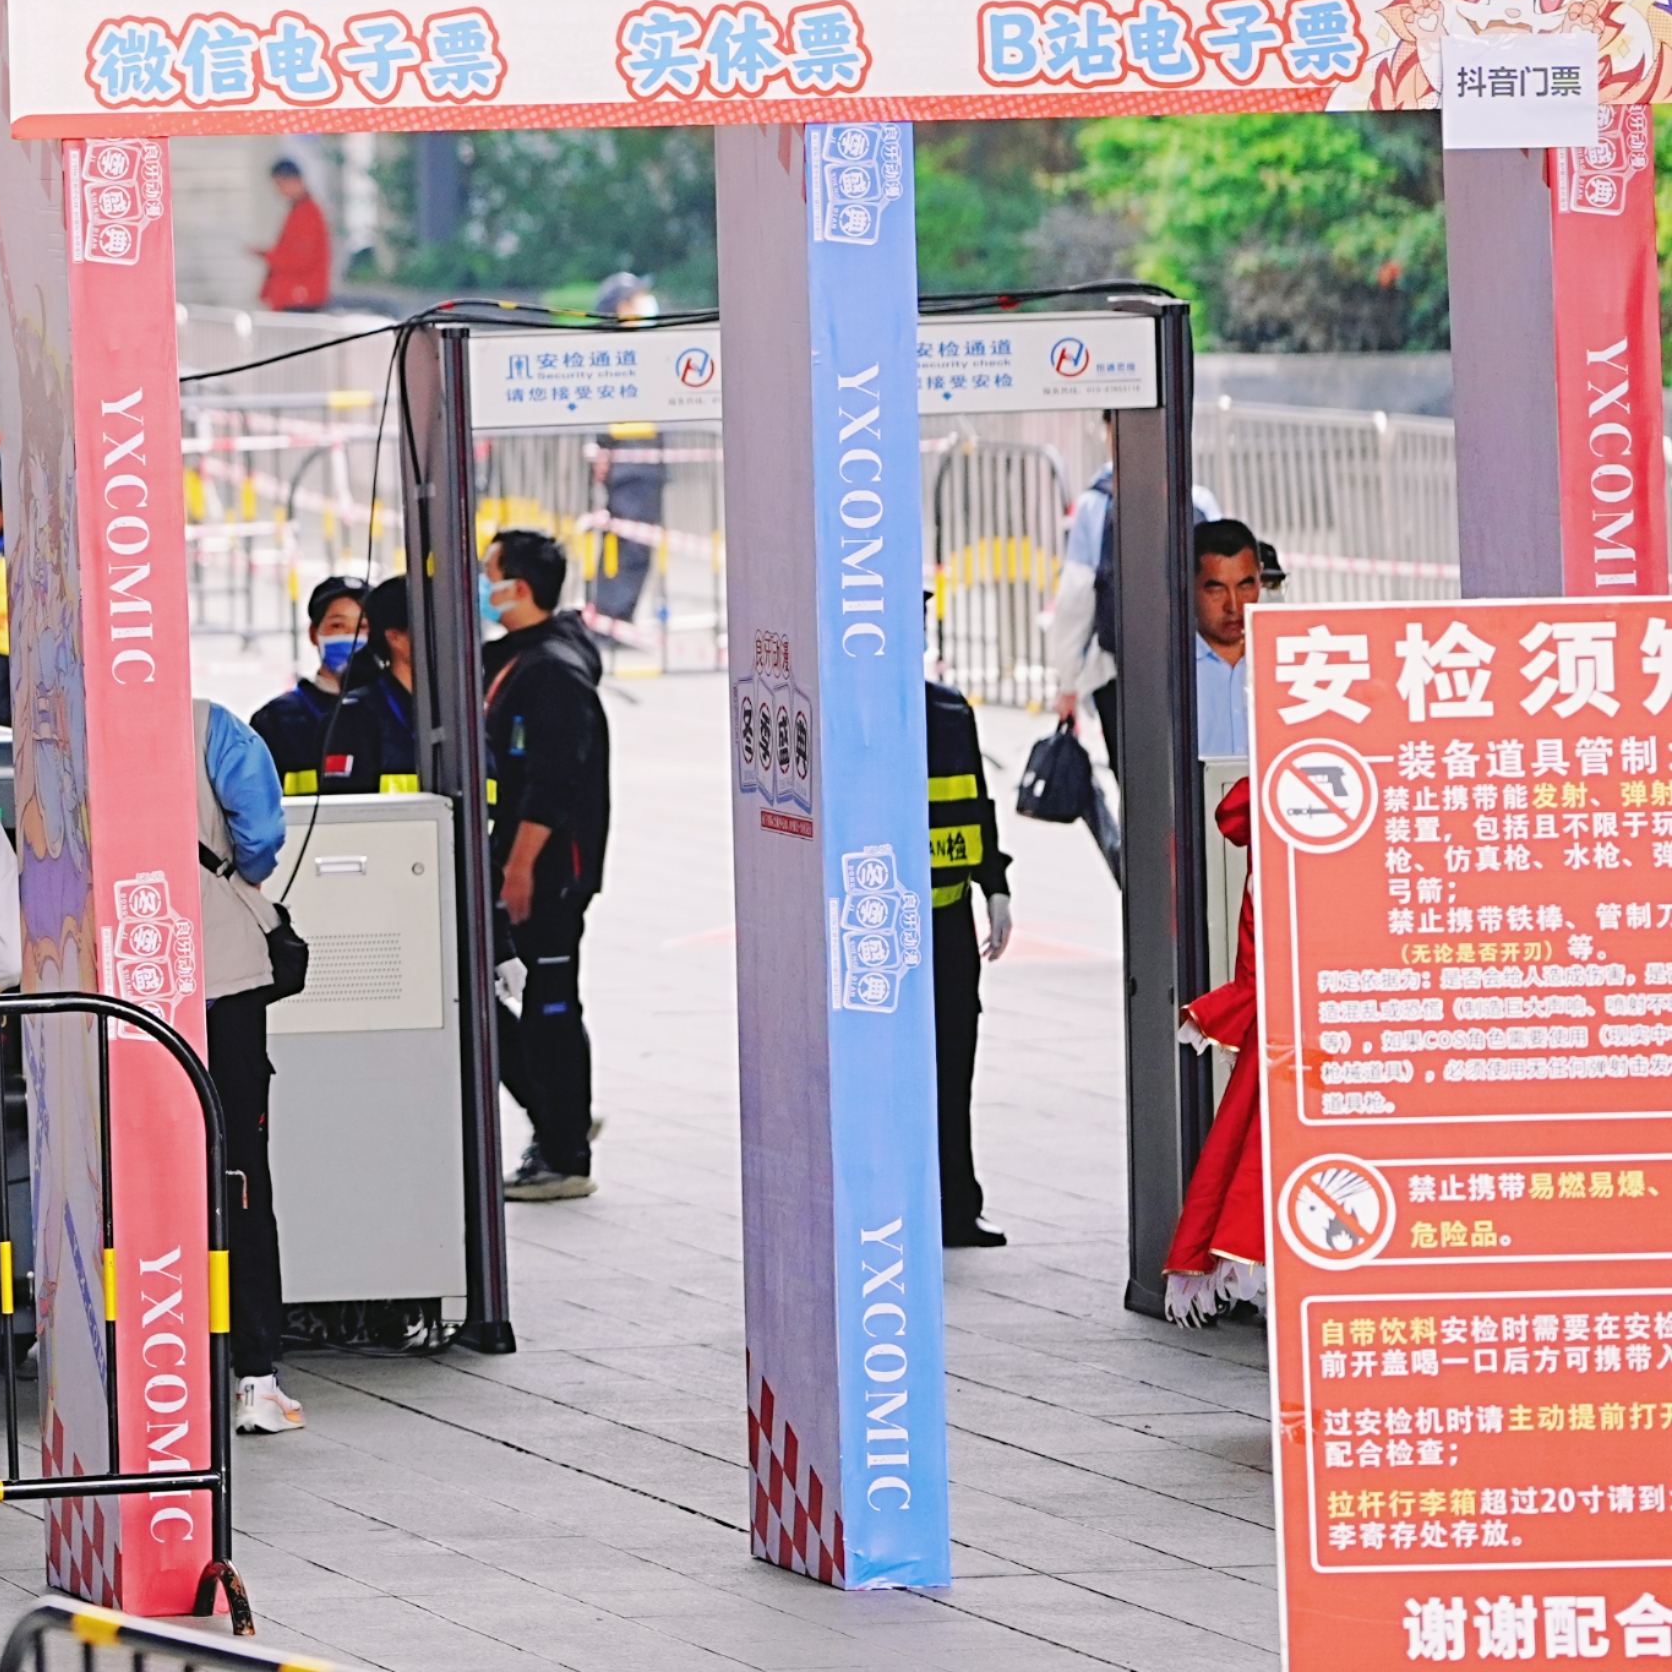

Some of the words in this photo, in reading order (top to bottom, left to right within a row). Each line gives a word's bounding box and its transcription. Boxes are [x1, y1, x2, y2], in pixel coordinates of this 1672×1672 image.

[86, 9, 507, 110] 微信电子票
[1456, 65, 1583, 99] 抖音门票
[536, 350, 638, 370] 安检通道
[536, 369, 595, 381] Security
[598, 368, 637, 378] check
[505, 383, 640, 403] 请您接受安检
[918, 373, 1014, 390] 接受安检
[1587, 338, 1638, 588] YXCOMI
[837, 363, 886, 658] YXCOMIC
[101, 387, 156, 685] YXCOMIC
[1408, 1170, 1660, 1203] 禁止携带易燃易爆、
[1410, 1220, 1512, 1250] 危险品。
[858, 1217, 911, 1513] YXCOMIC
[1324, 1439, 1459, 1468] 配合检查；
[1327, 1484, 1672, 1519] 拉杆行李箱超过20寸请到
[1328, 1519, 1525, 1551] 李寄存处存放。
[1402, 1591, 1672, 1661] 谢谢配合
